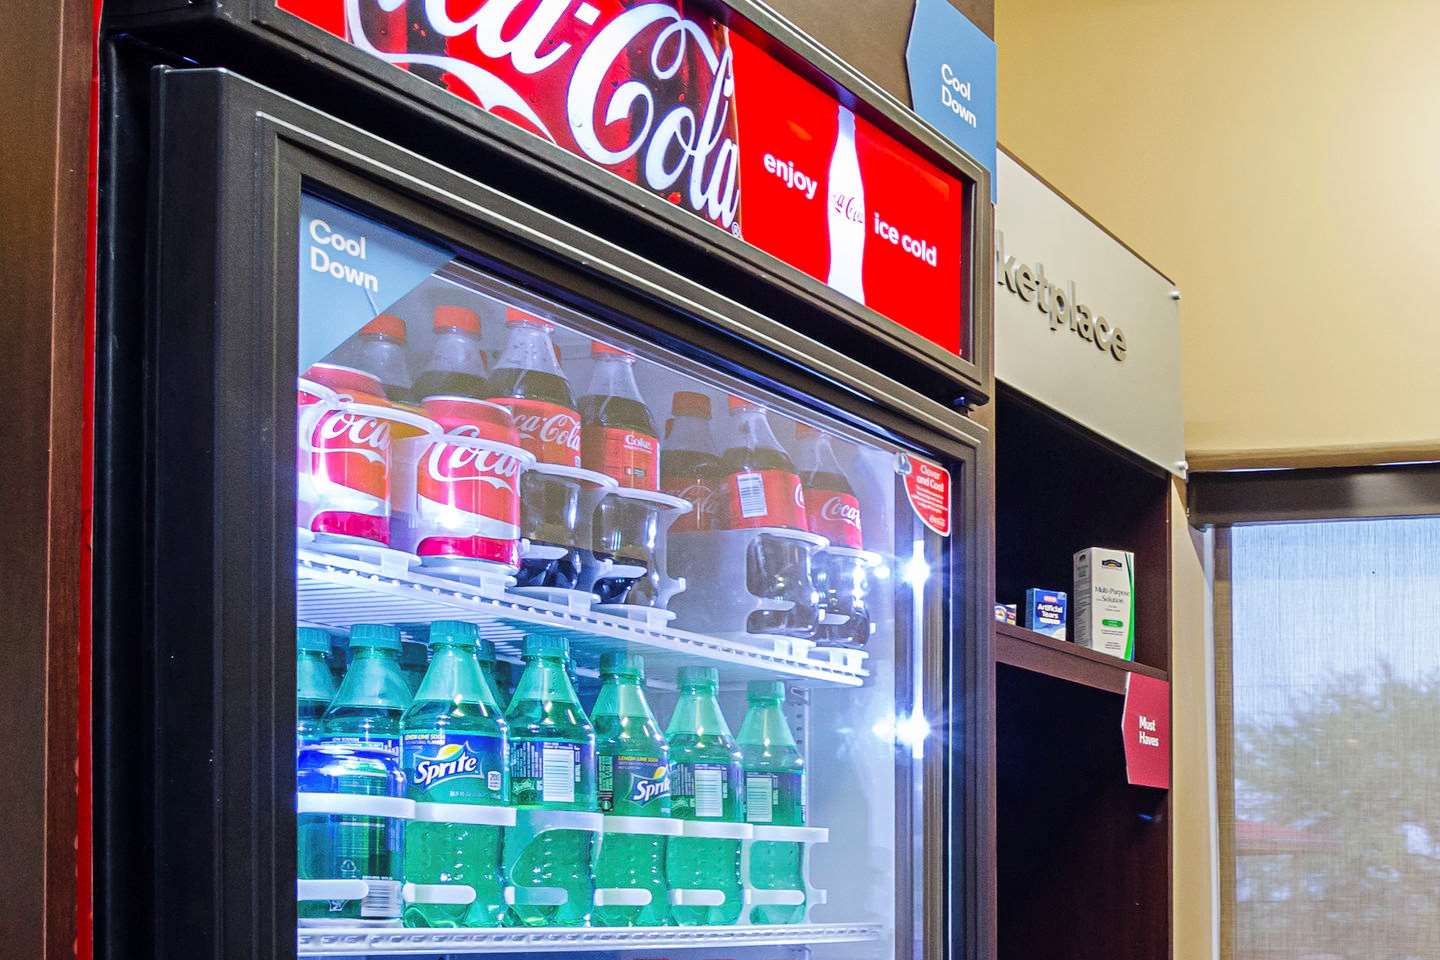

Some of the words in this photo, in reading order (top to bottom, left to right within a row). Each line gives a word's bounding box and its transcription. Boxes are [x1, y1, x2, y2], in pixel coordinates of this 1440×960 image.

[941, 64, 971, 101] Cool
[941, 85, 977, 128] Down
[763, 153, 818, 200] enjoy
[873, 212, 899, 245] ice
[901, 234, 937, 267] cold
[309, 219, 367, 260] Cool
[310, 245, 378, 293] Down
[1139, 715, 1156, 732] Must
[1139, 731, 1159, 747] Haves
[414, 752, 477, 785] Sprite
